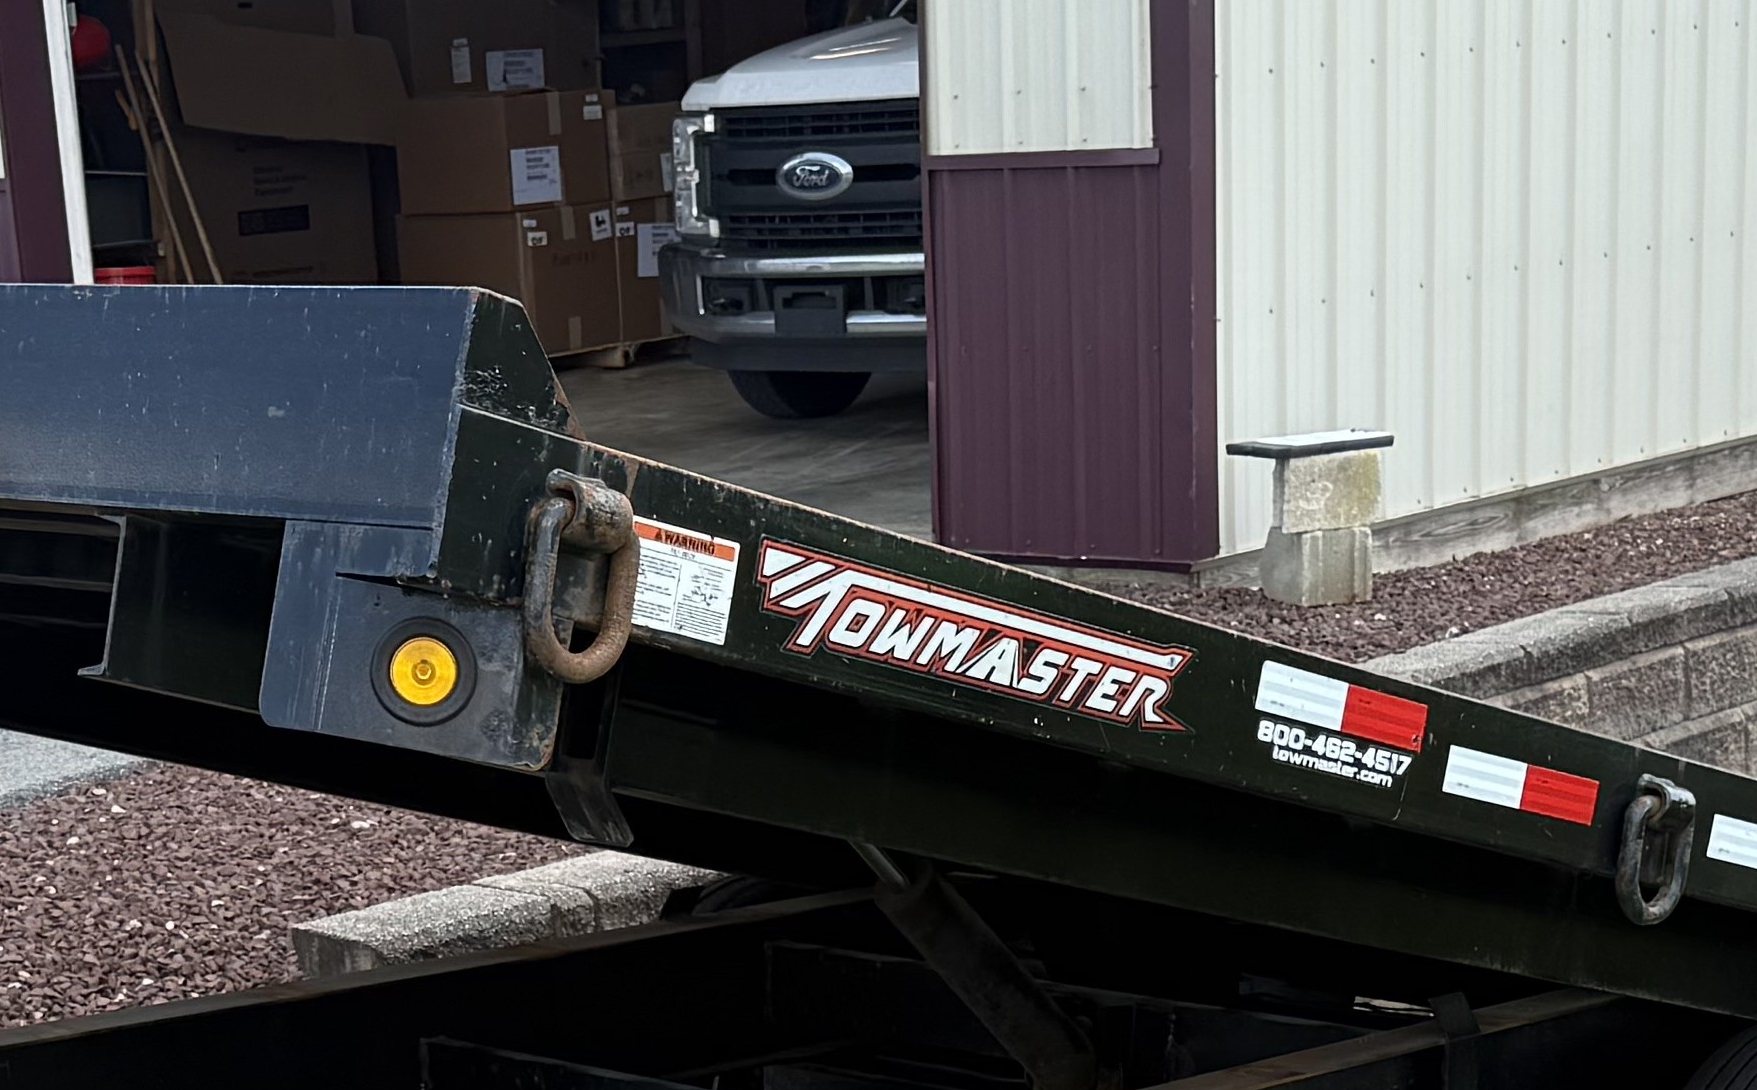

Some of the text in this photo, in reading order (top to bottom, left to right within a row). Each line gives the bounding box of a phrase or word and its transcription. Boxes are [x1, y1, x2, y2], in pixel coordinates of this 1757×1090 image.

[793, 166, 829, 187] Ford
[663, 530, 716, 555] WARNING
[762, 547, 1184, 723] TOWMASTER
[1256, 719, 1413, 776] 800-462-4517
[1272, 745, 1393, 788] towmaster.com
